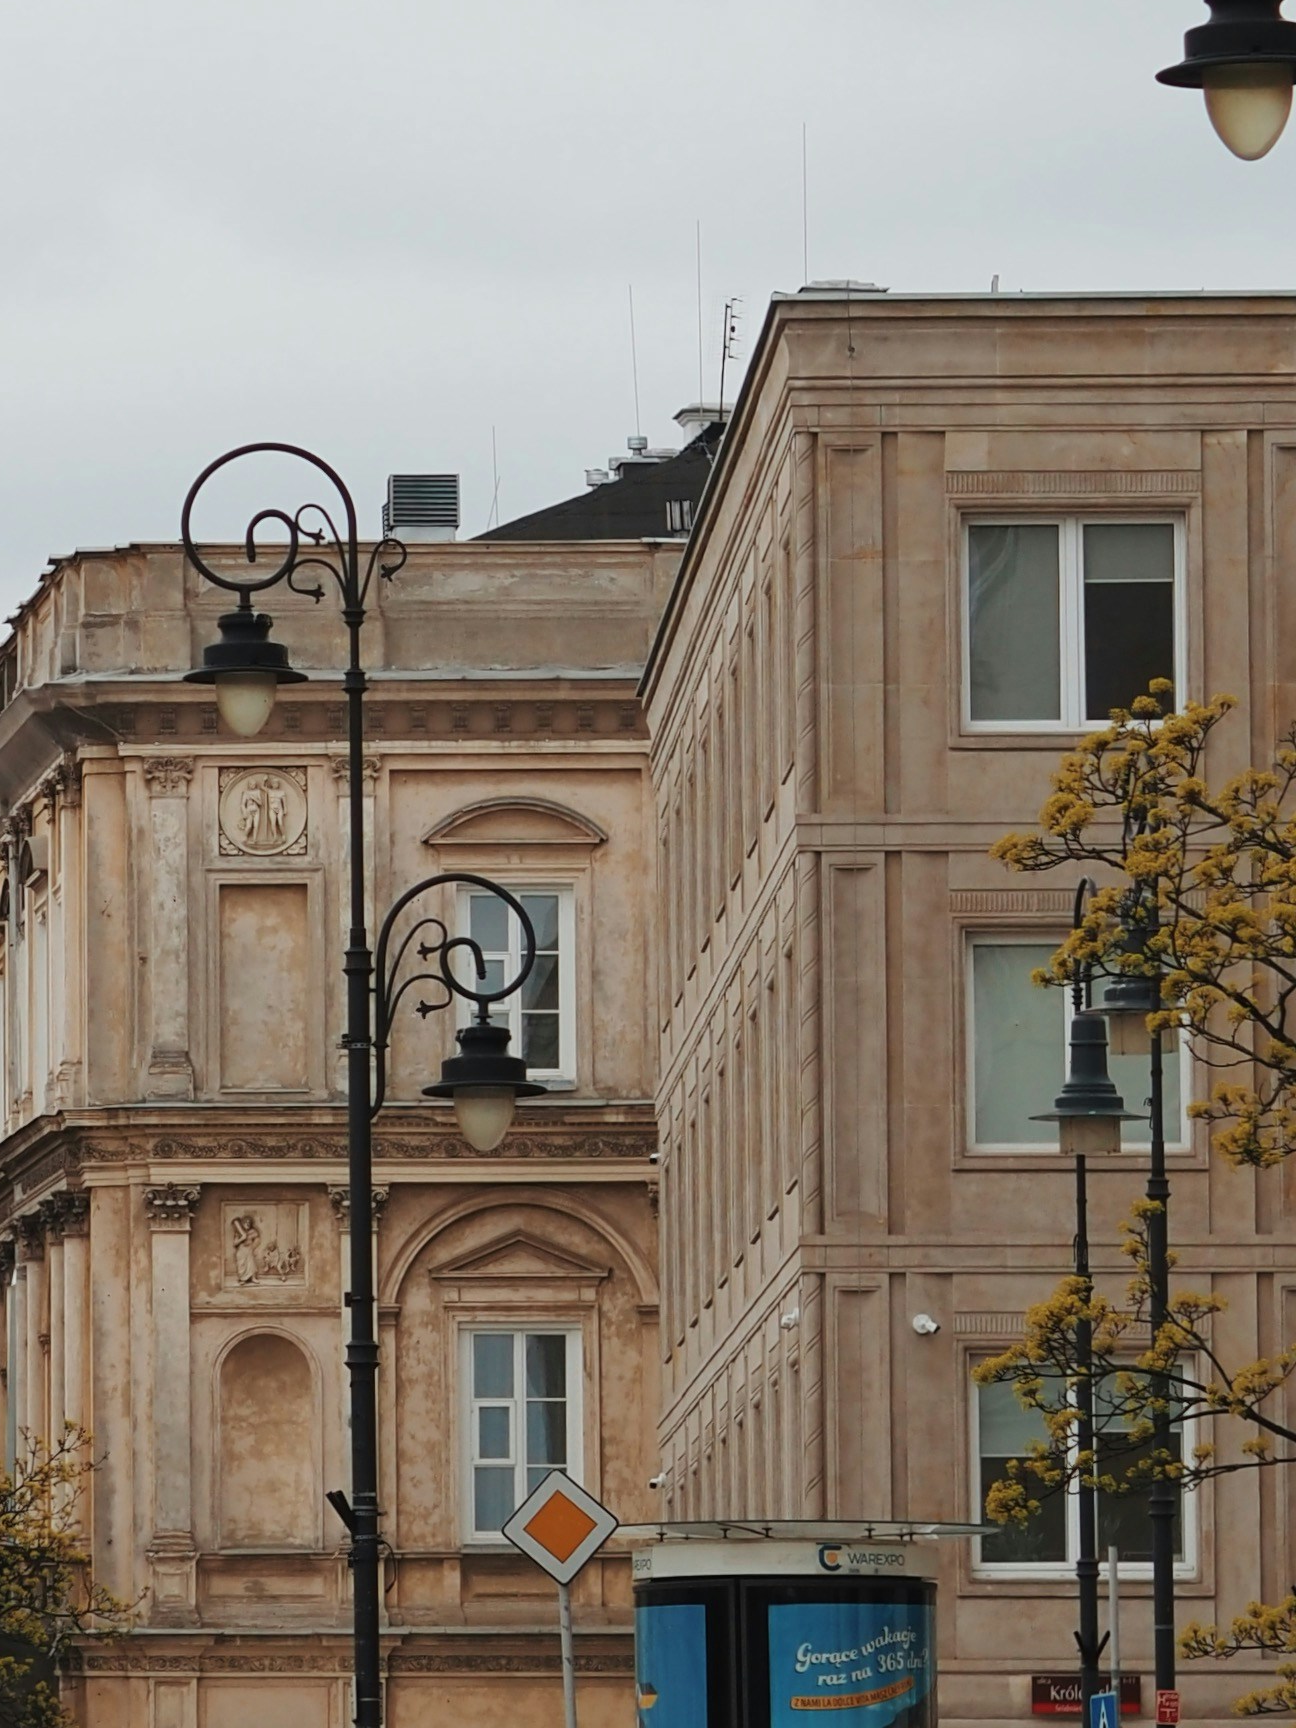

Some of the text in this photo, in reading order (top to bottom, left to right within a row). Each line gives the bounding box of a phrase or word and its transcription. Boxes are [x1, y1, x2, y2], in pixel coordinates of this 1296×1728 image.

[848, 1552, 905, 1567] WAREXPO
[795, 1626, 916, 1673] Gorące wakacje
[818, 1674, 847, 1686] raz
[852, 1666, 872, 1682] na
[877, 1652, 904, 1673] 365
